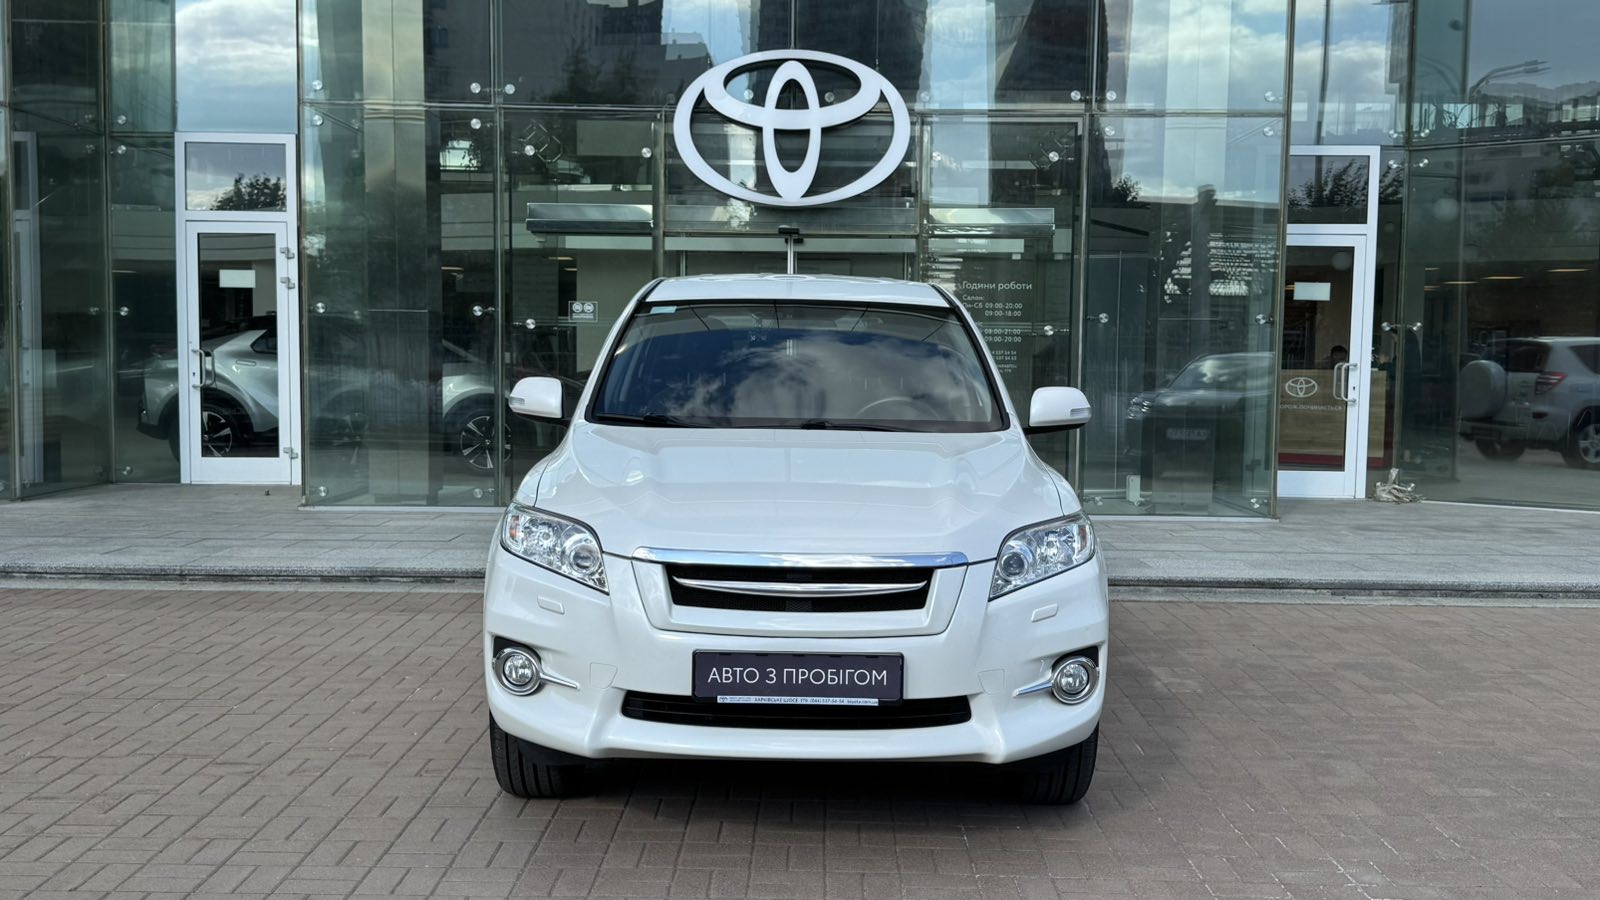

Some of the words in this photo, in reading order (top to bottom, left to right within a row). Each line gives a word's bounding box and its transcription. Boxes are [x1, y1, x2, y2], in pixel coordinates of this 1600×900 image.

[962, 281, 996, 290] Години
[998, 281, 1032, 292] роботи
[707, 667, 760, 684] АВТО
[765, 668, 777, 684] З
[783, 669, 887, 686] ПРОБІГОМ
